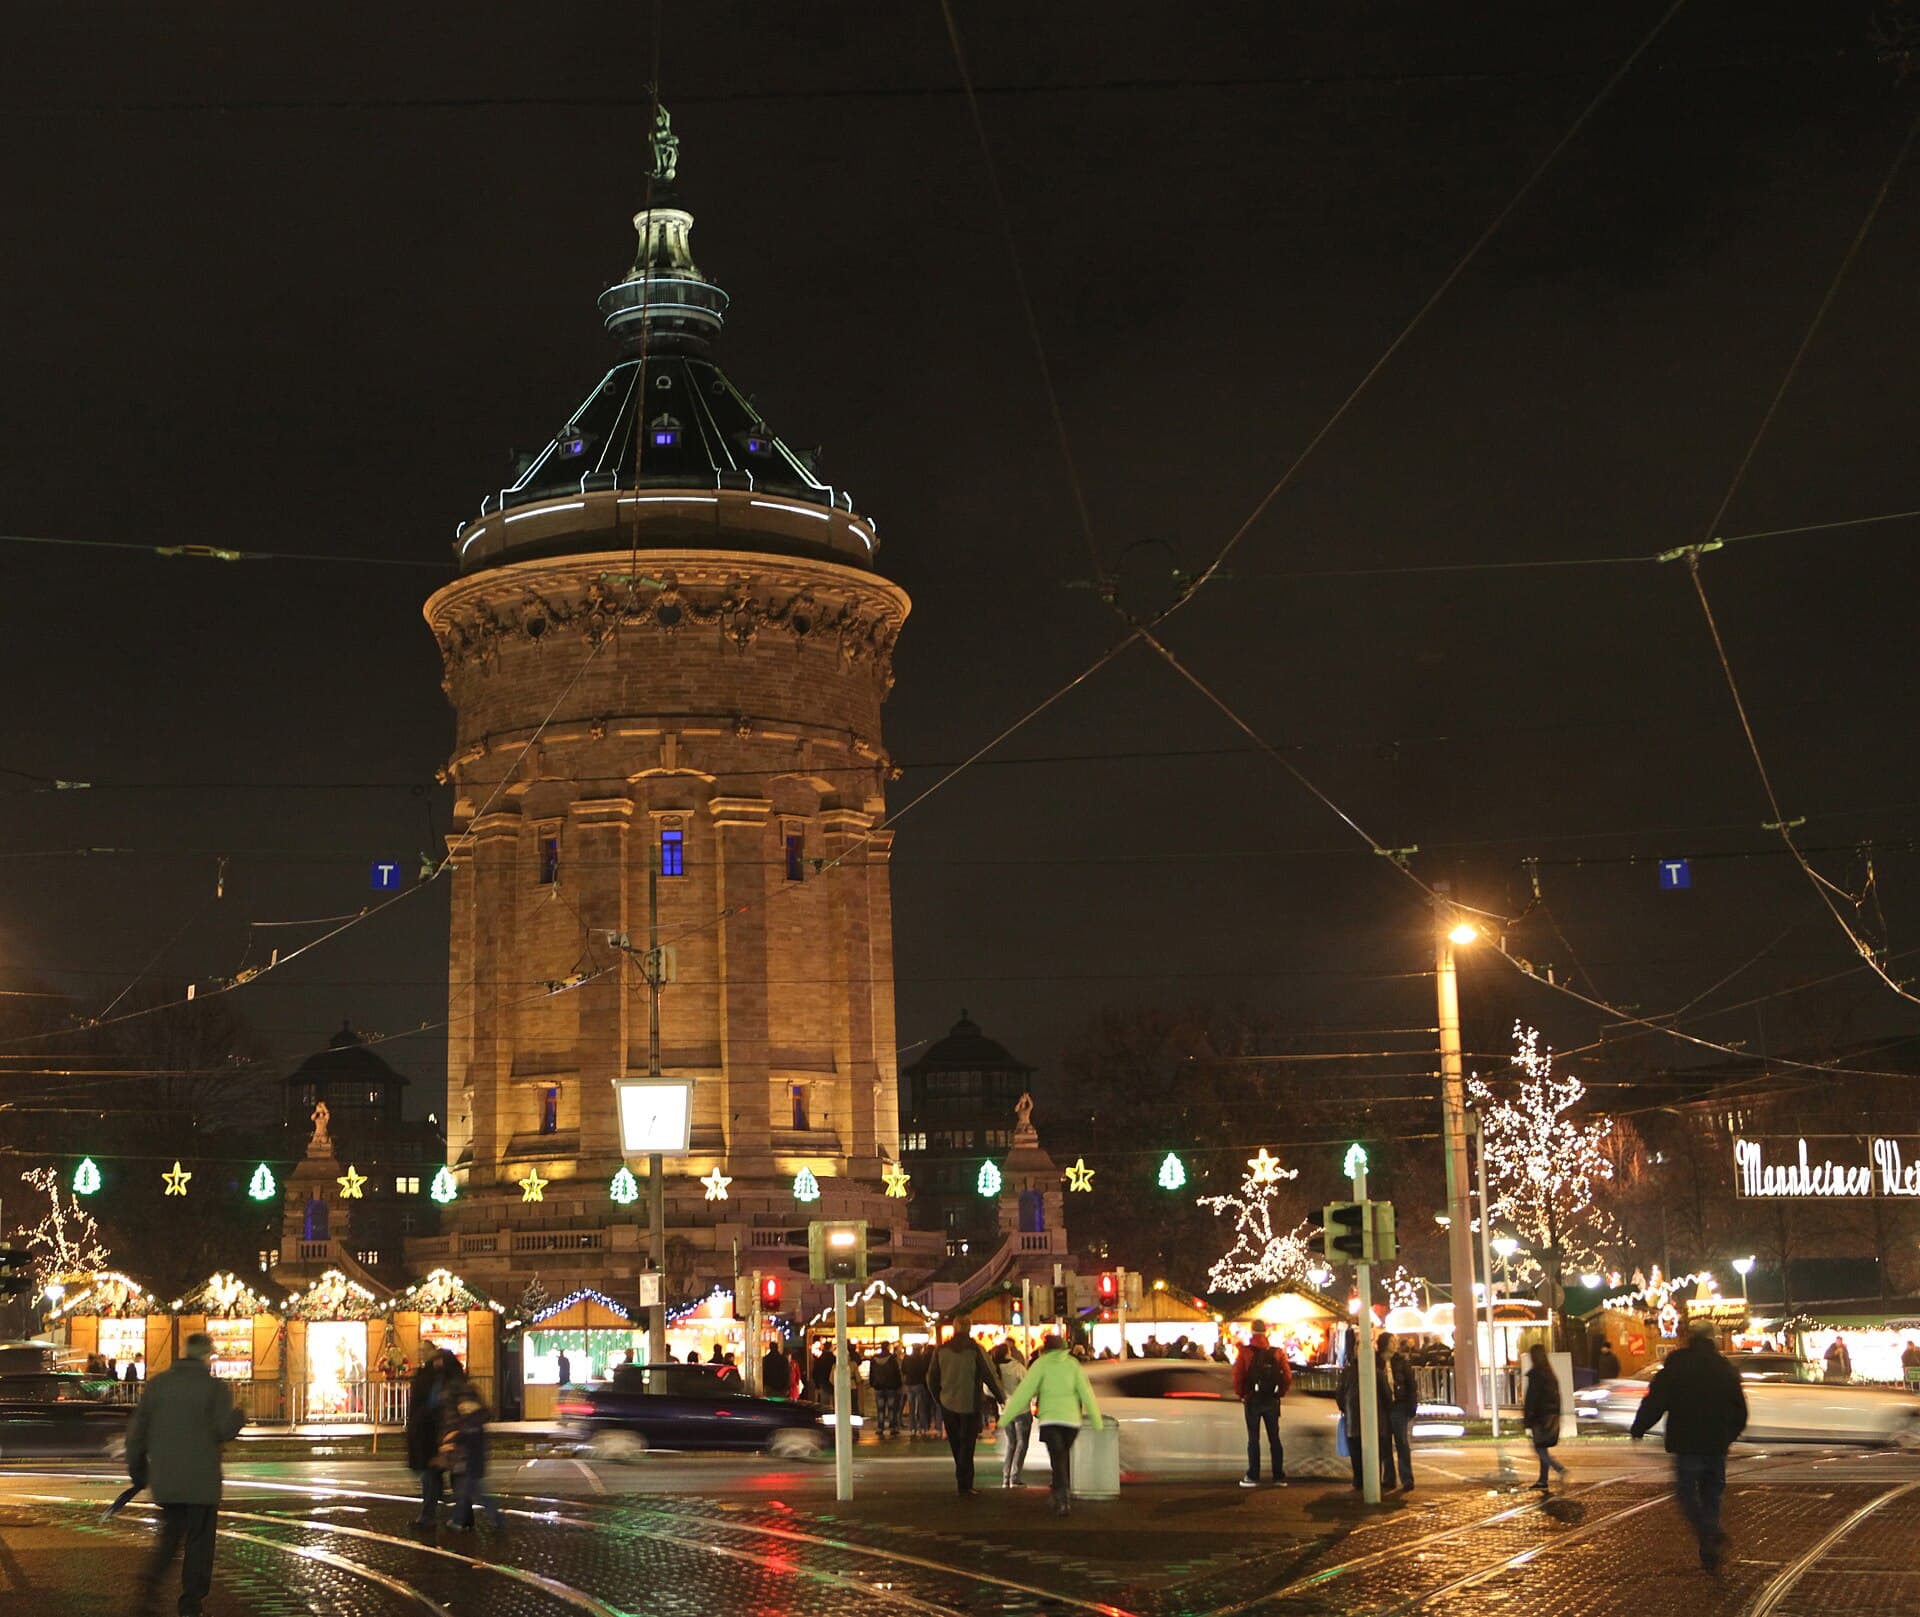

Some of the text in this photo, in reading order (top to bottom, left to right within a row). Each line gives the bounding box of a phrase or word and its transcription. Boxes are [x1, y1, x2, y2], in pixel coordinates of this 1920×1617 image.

[378, 865, 394, 886] T
[1665, 863, 1682, 885] T
[1735, 1138, 1871, 1196] Mannheimer
